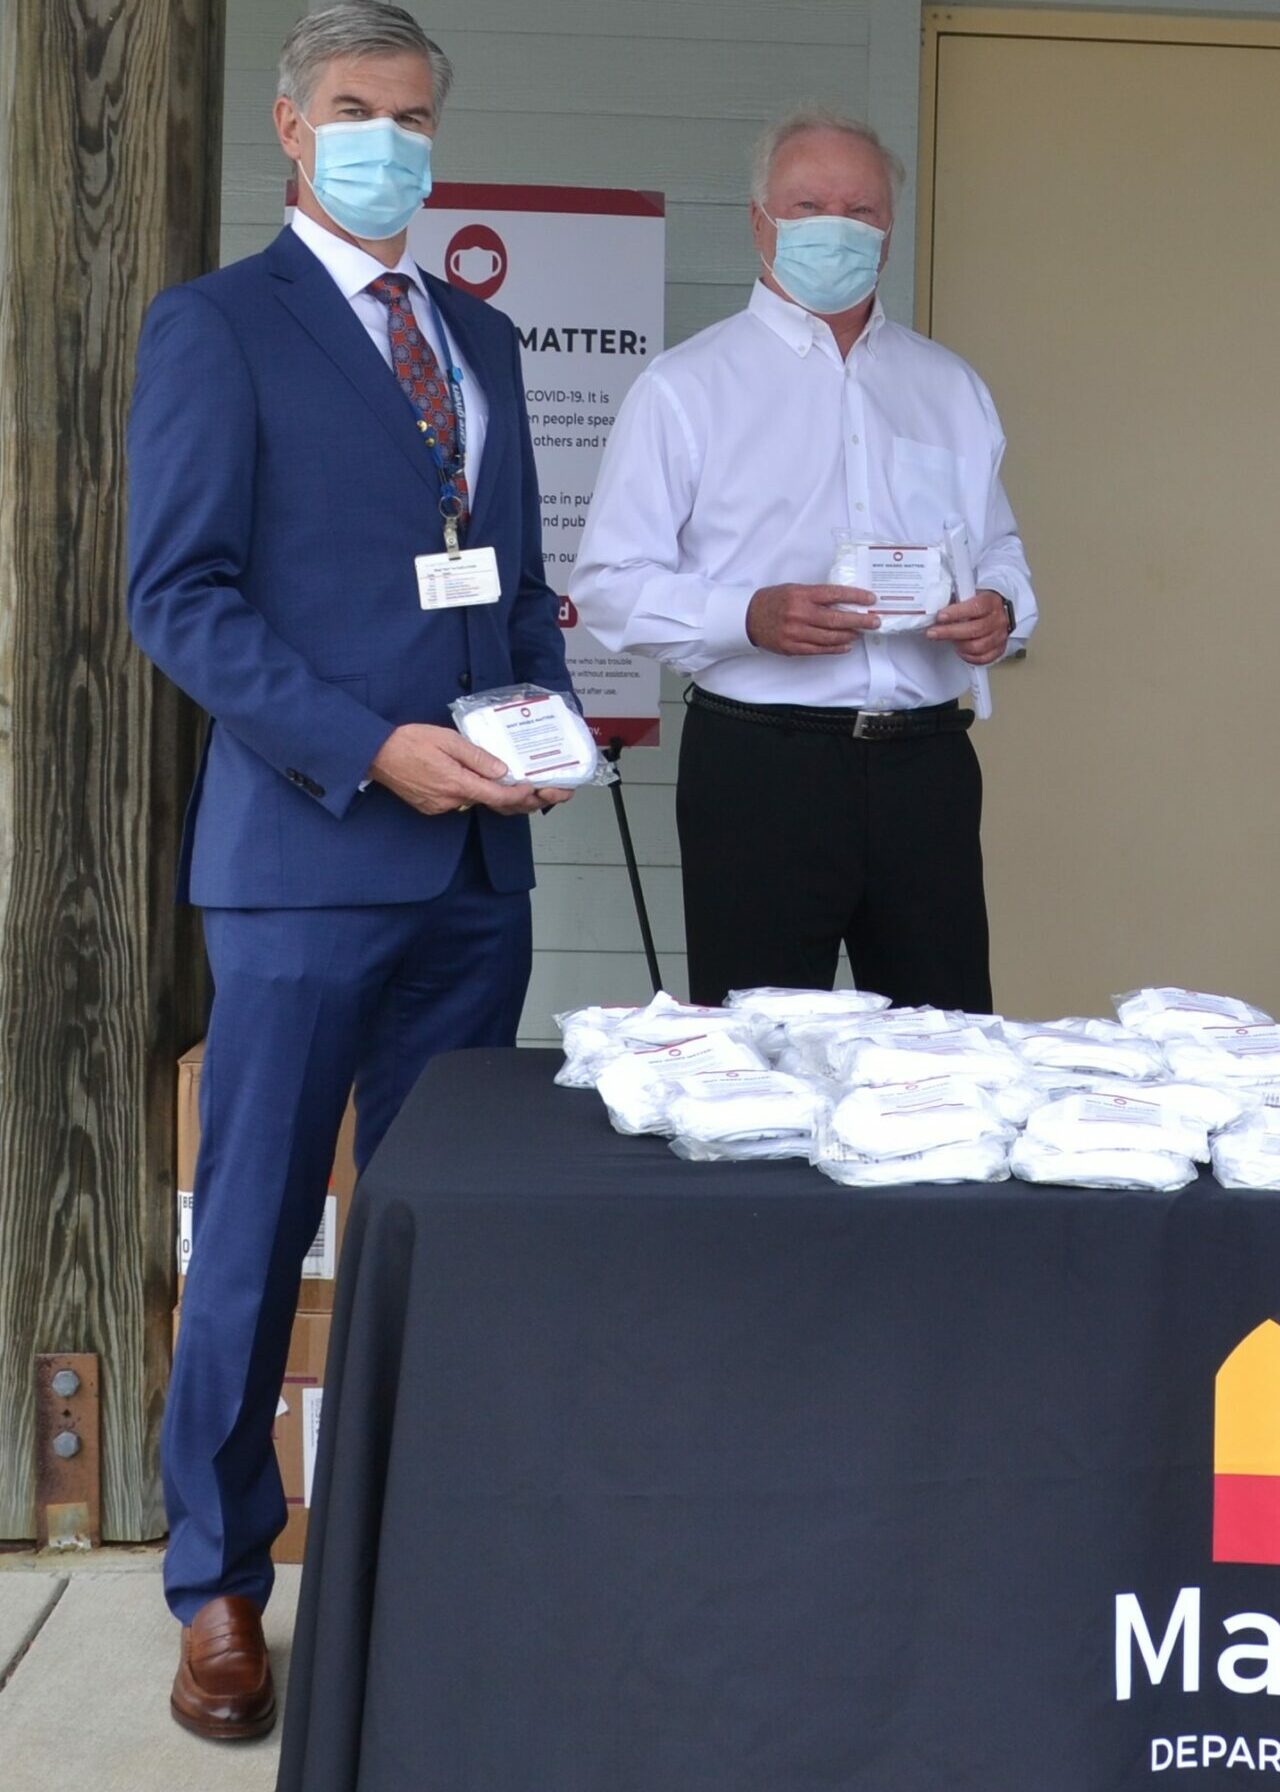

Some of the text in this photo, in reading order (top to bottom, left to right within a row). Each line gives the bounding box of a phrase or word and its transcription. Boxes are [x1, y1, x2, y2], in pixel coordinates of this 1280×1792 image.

[526, 389, 610, 404] COVID-19. It is
[543, 413, 585, 428] people
[587, 415, 615, 428] spea
[533, 434, 573, 447] others
[575, 435, 599, 448] and
[560, 491, 572, 505] in
[542, 515, 559, 528] nd
